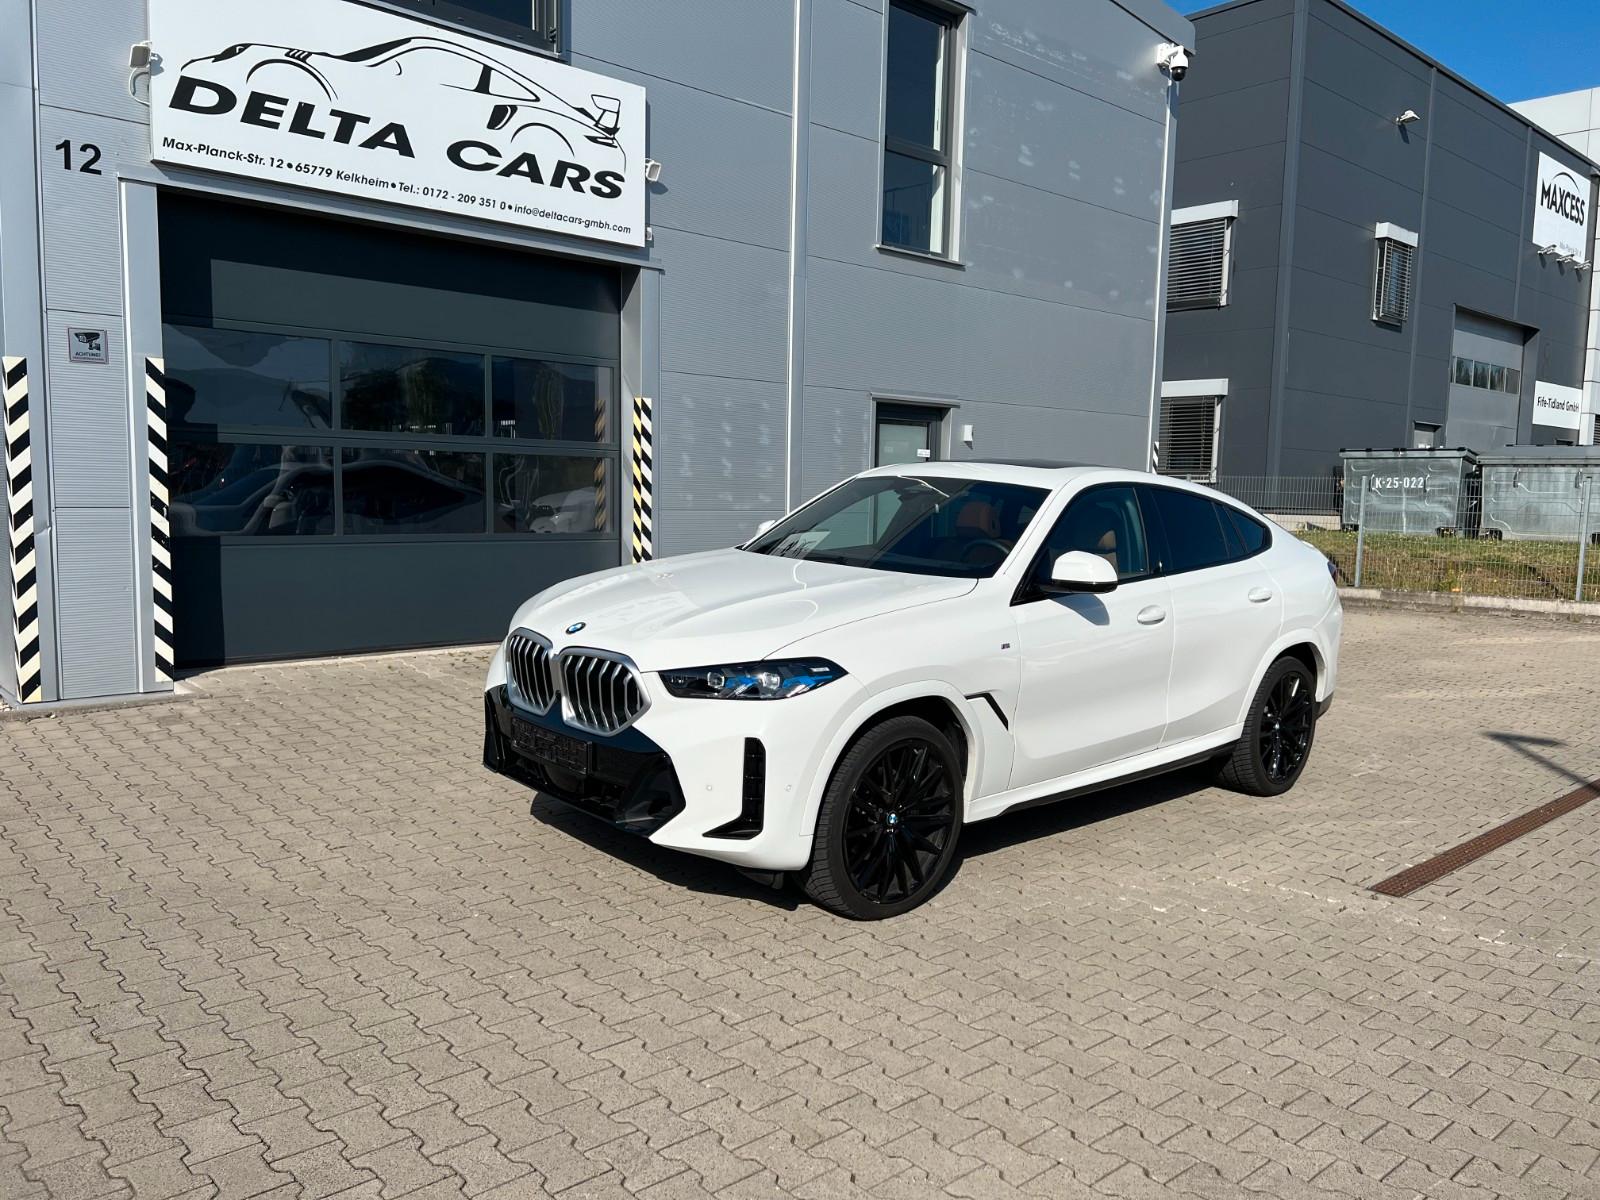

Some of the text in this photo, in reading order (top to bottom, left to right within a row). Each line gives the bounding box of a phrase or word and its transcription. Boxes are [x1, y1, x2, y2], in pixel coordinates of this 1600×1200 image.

[55, 139, 102, 175] 12
[168, 75, 626, 200] DELTA CARS
[162, 136, 266, 166] Max-Planck-Str.
[269, 157, 284, 169] 12
[295, 162, 333, 178] 65779
[336, 170, 389, 189] Kelkheim
[399, 181, 420, 195] Tel.:
[422, 186, 448, 200] 0172
[458, 193, 476, 205] 209
[479, 197, 496, 209] 351
[500, 201, 506, 210] 0
[514, 203, 631, 234] info@deltacars-gmbh.com
[1540, 179, 1585, 226] MAXCESS
